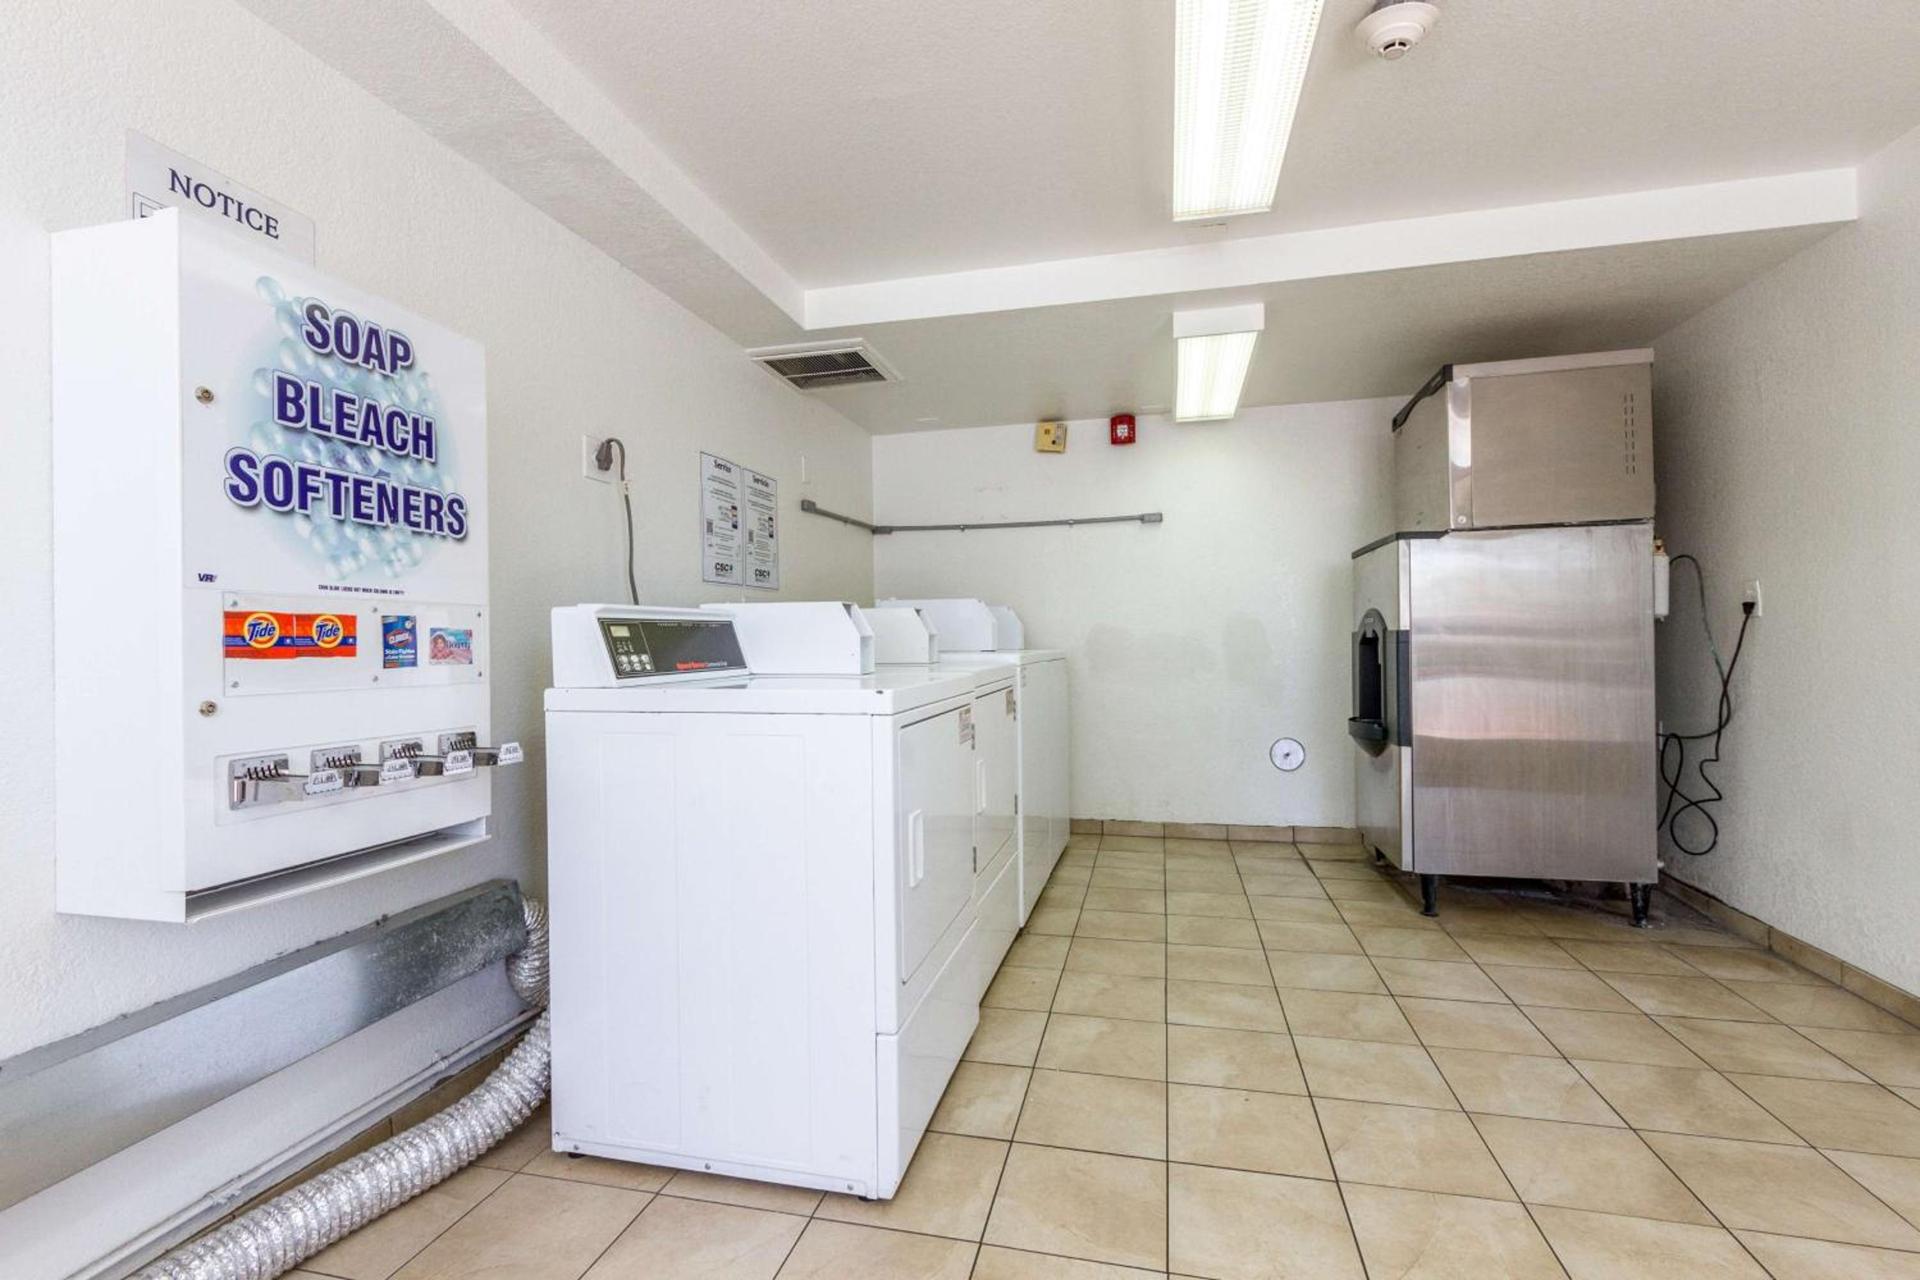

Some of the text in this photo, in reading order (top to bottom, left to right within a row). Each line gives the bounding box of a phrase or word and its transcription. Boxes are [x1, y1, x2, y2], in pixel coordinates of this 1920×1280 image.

[168, 168, 279, 239] NOTICE
[302, 298, 414, 377] SOAP
[273, 371, 437, 462] BLEACH
[225, 448, 468, 540] SOFTENERS
[247, 621, 276, 642] Tide
[315, 622, 340, 642] Tide
